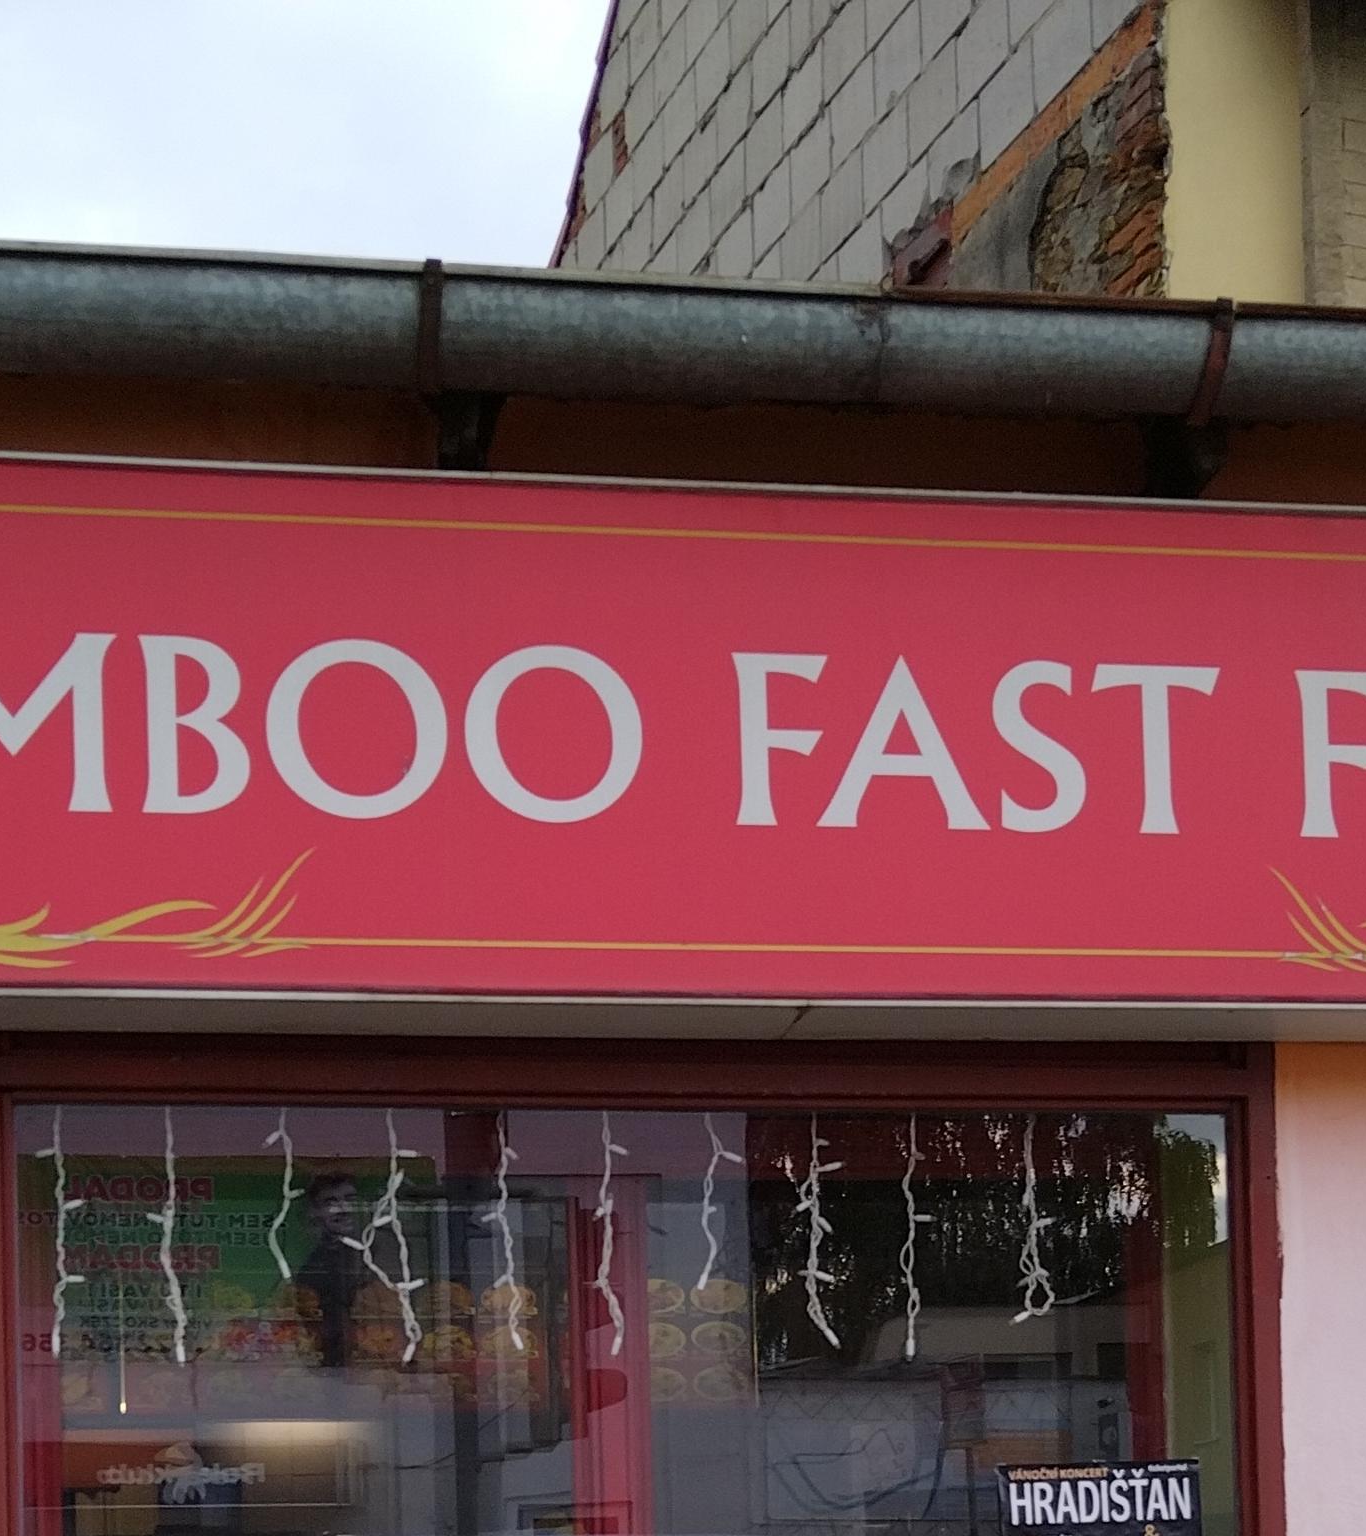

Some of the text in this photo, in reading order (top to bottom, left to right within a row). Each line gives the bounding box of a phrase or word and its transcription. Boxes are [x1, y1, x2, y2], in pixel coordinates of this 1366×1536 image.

[730, 651, 1222, 835] FAST
[1009, 1468, 1192, 1526] HRADIŠŤAN
[1060, 1466, 1109, 1479] KONCERT
